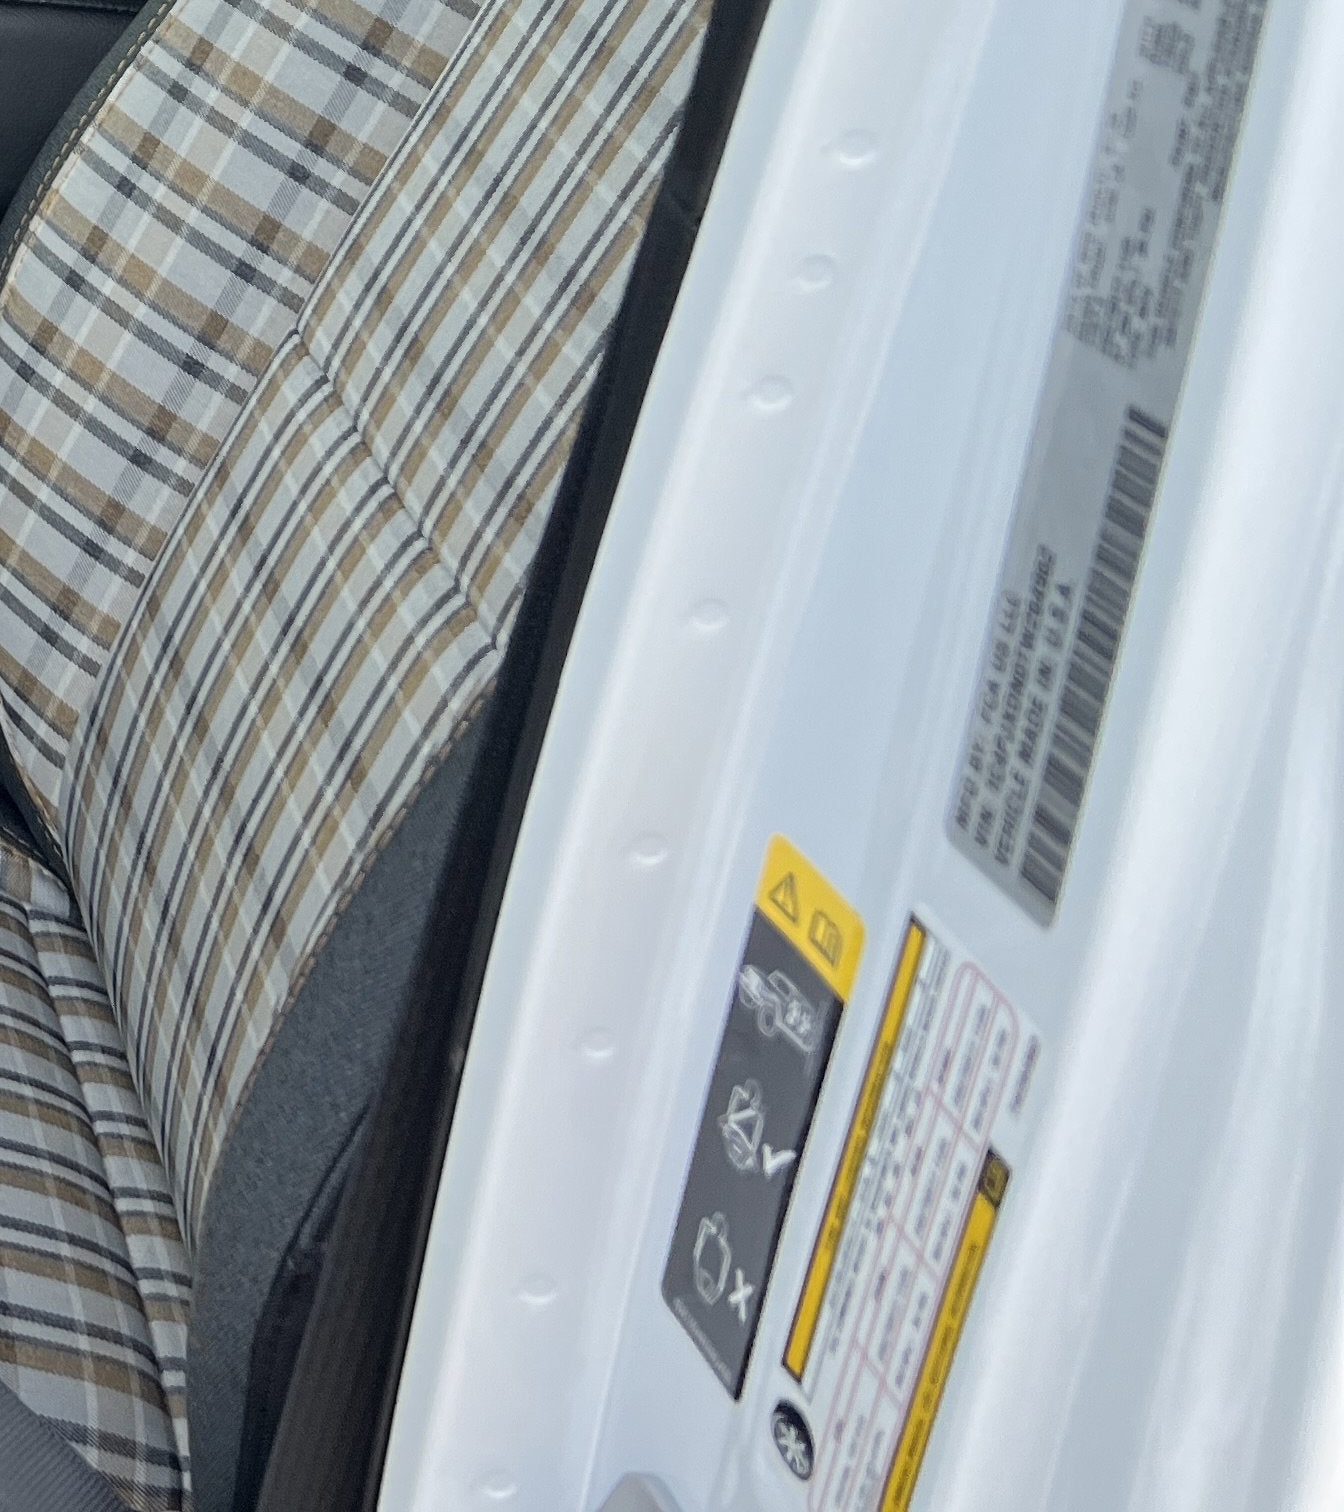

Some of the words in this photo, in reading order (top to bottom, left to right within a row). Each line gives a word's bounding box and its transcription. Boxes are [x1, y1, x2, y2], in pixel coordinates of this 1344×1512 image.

[994, 772, 1026, 866] VEHICLE
[1018, 694, 1045, 766] MADE
[1036, 659, 1054, 691] IN
